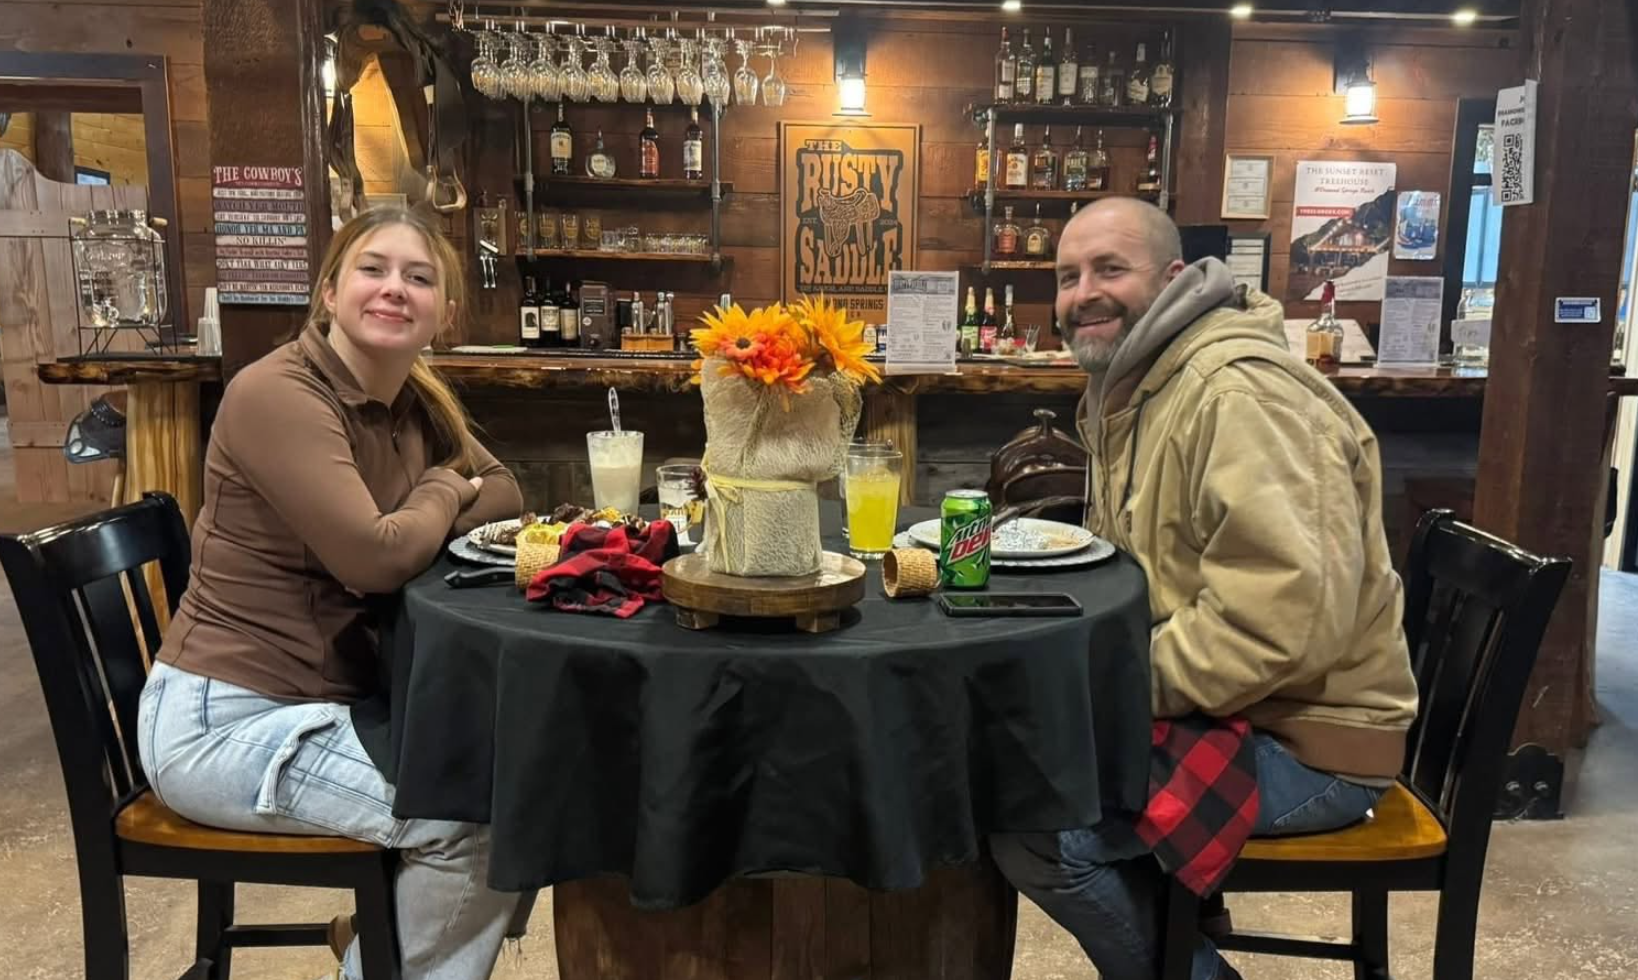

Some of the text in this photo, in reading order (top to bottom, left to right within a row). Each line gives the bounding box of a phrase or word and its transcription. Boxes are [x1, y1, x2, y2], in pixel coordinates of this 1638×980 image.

[805, 140, 842, 151] THE
[213, 166, 303, 187] THE COWBOY'S
[1307, 167, 1323, 175] THE
[1325, 167, 1357, 175] SUNSET
[801, 153, 899, 213] RUSTY
[236, 236, 287, 245] NO KILLIN'
[801, 226, 898, 283] SADDLE
[849, 298, 885, 310] SPRINGS
